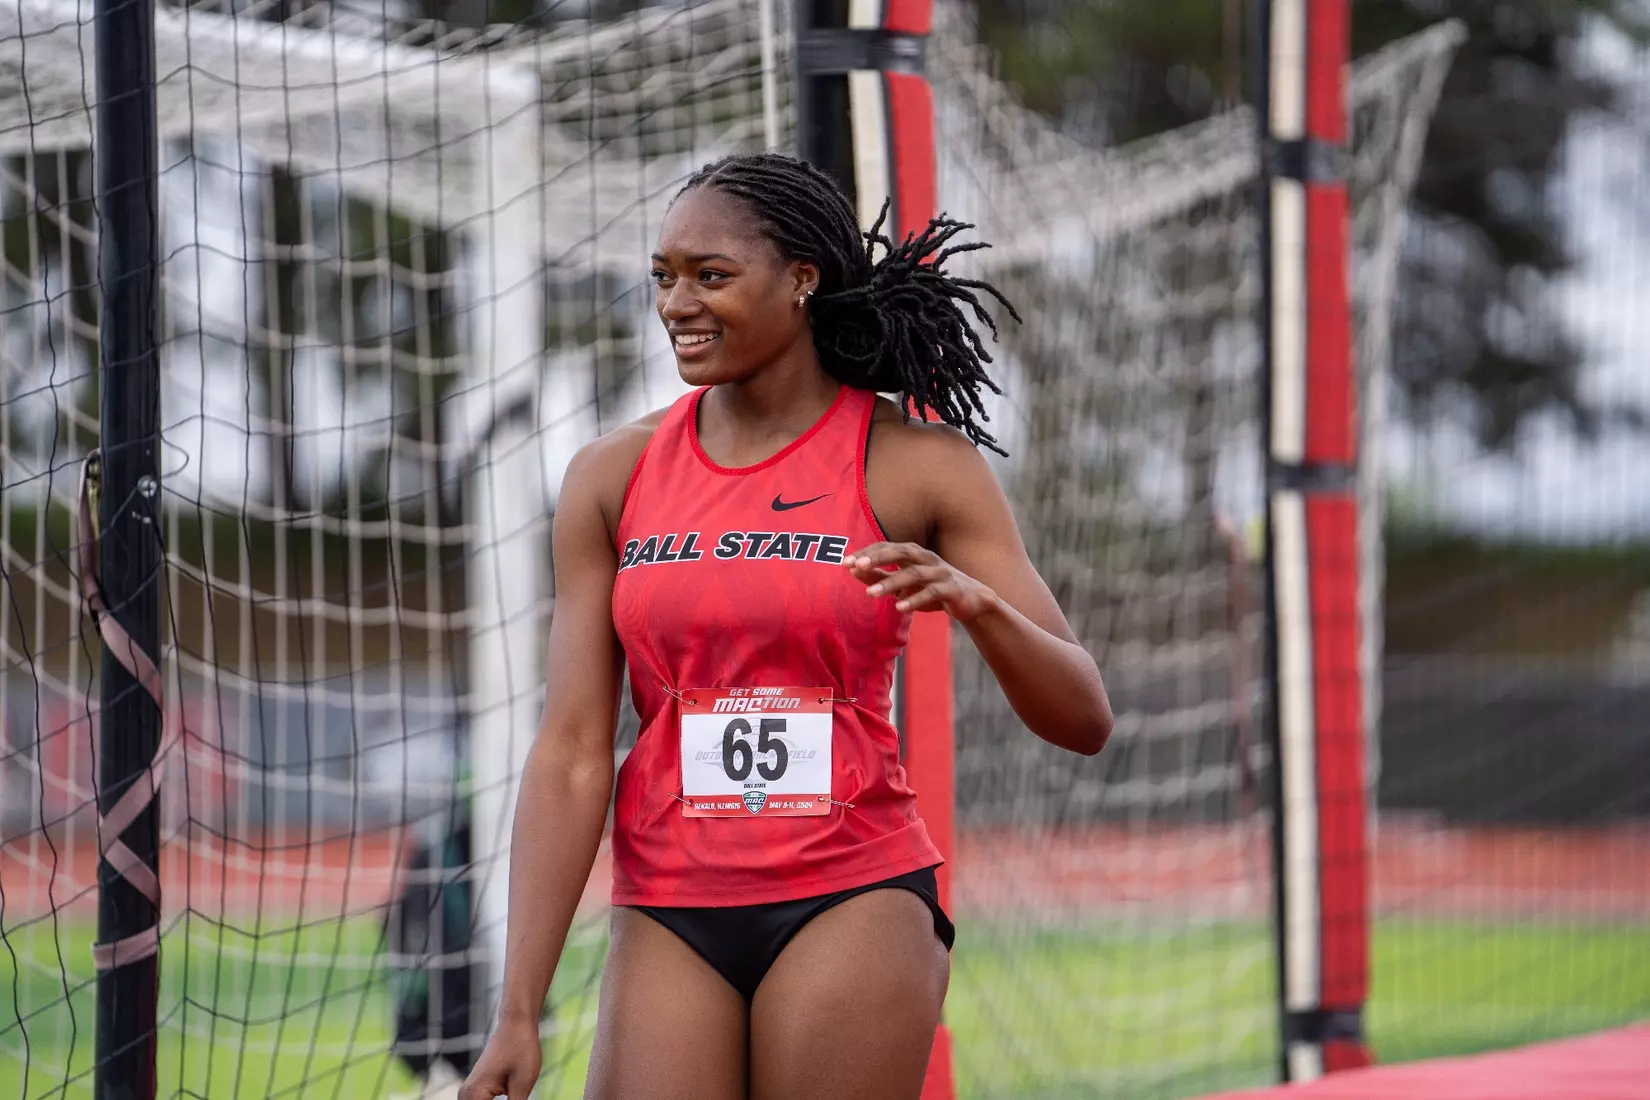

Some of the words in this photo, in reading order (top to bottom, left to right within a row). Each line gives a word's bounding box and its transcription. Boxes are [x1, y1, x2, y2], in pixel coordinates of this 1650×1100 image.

[618, 531, 704, 573] BALL
[714, 531, 849, 565] STATE
[729, 688, 750, 696] GET
[752, 688, 784, 696] SOME
[723, 717, 788, 781] 65
[768, 801, 782, 809] MAY
